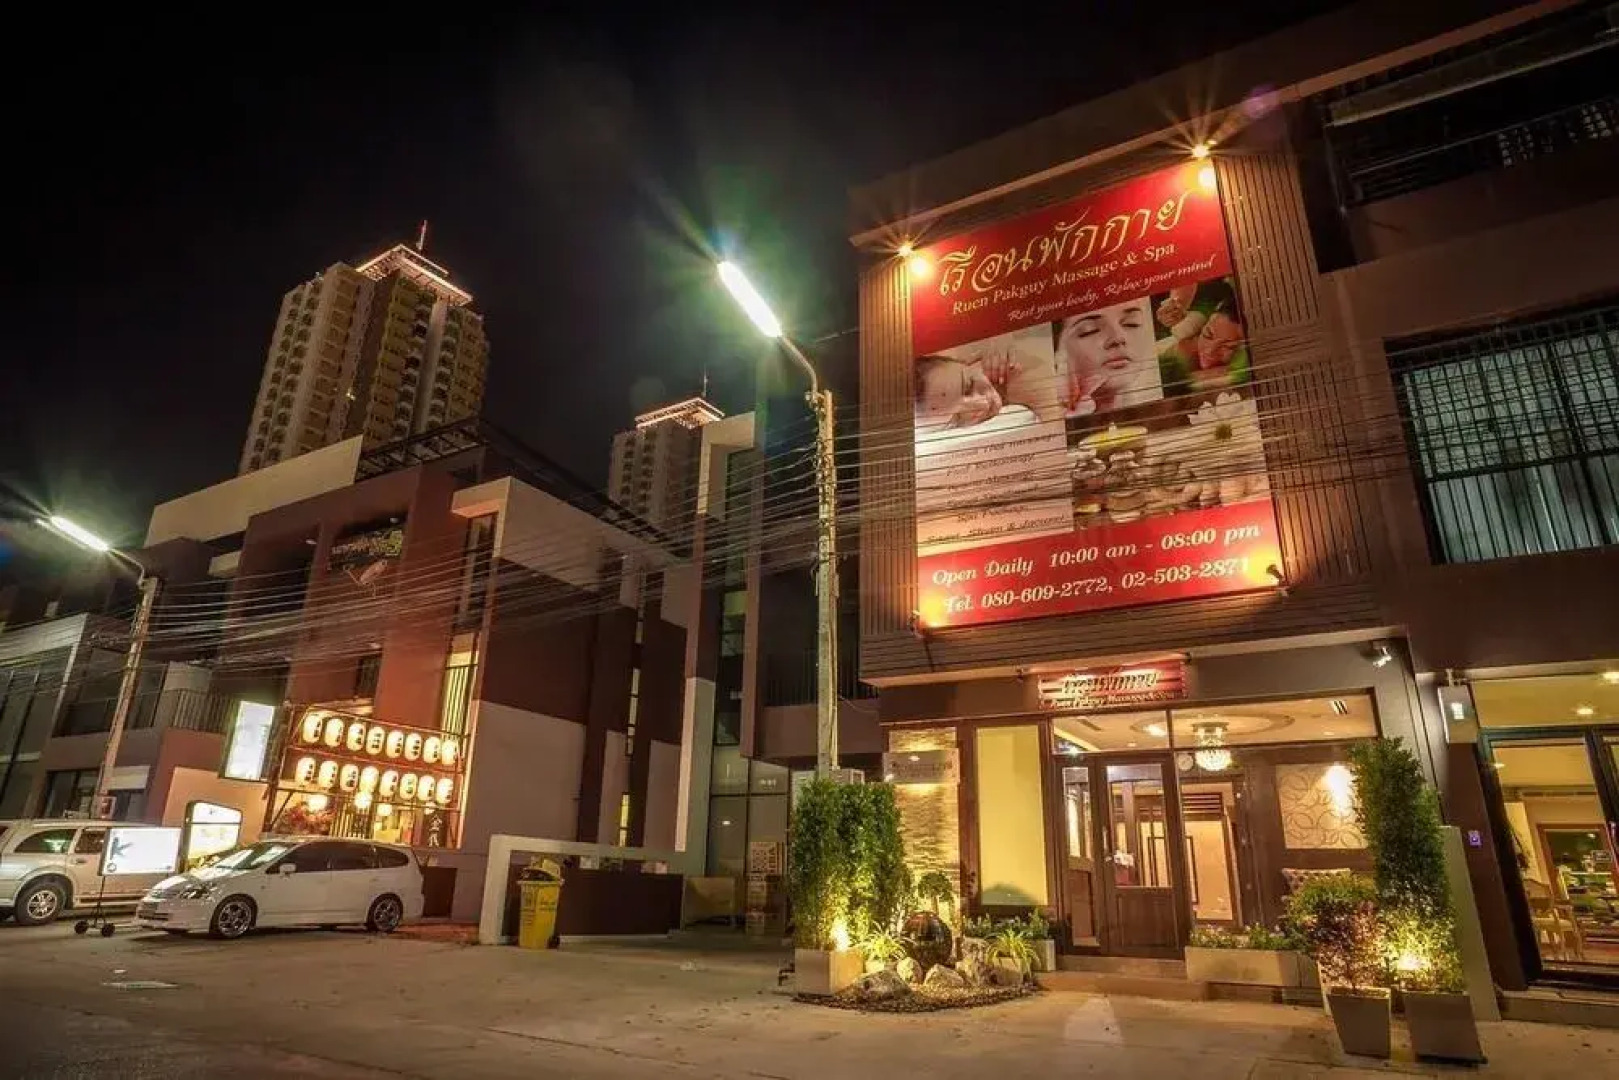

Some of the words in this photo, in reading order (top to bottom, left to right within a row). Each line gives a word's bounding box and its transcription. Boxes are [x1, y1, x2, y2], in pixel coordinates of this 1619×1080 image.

[938, 189, 1193, 296] เรือนพักกาย
[953, 296, 989, 314] Ruen
[994, 281, 1047, 303] Pakguy
[1052, 260, 1118, 286] Massage
[1123, 252, 1139, 267] &
[1144, 243, 1176, 262] Spa
[1037, 302, 1063, 320] your
[1144, 271, 1175, 291] your
[1178, 253, 1216, 275] mind
[932, 568, 978, 587] Open
[984, 557, 1034, 577] Daily
[1049, 546, 1099, 567] 10:00
[1106, 543, 1138, 558] am
[1161, 528, 1217, 550] 08:00
[1224, 524, 1260, 546] pm
[981, 576, 1113, 608] 080-609-2772,
